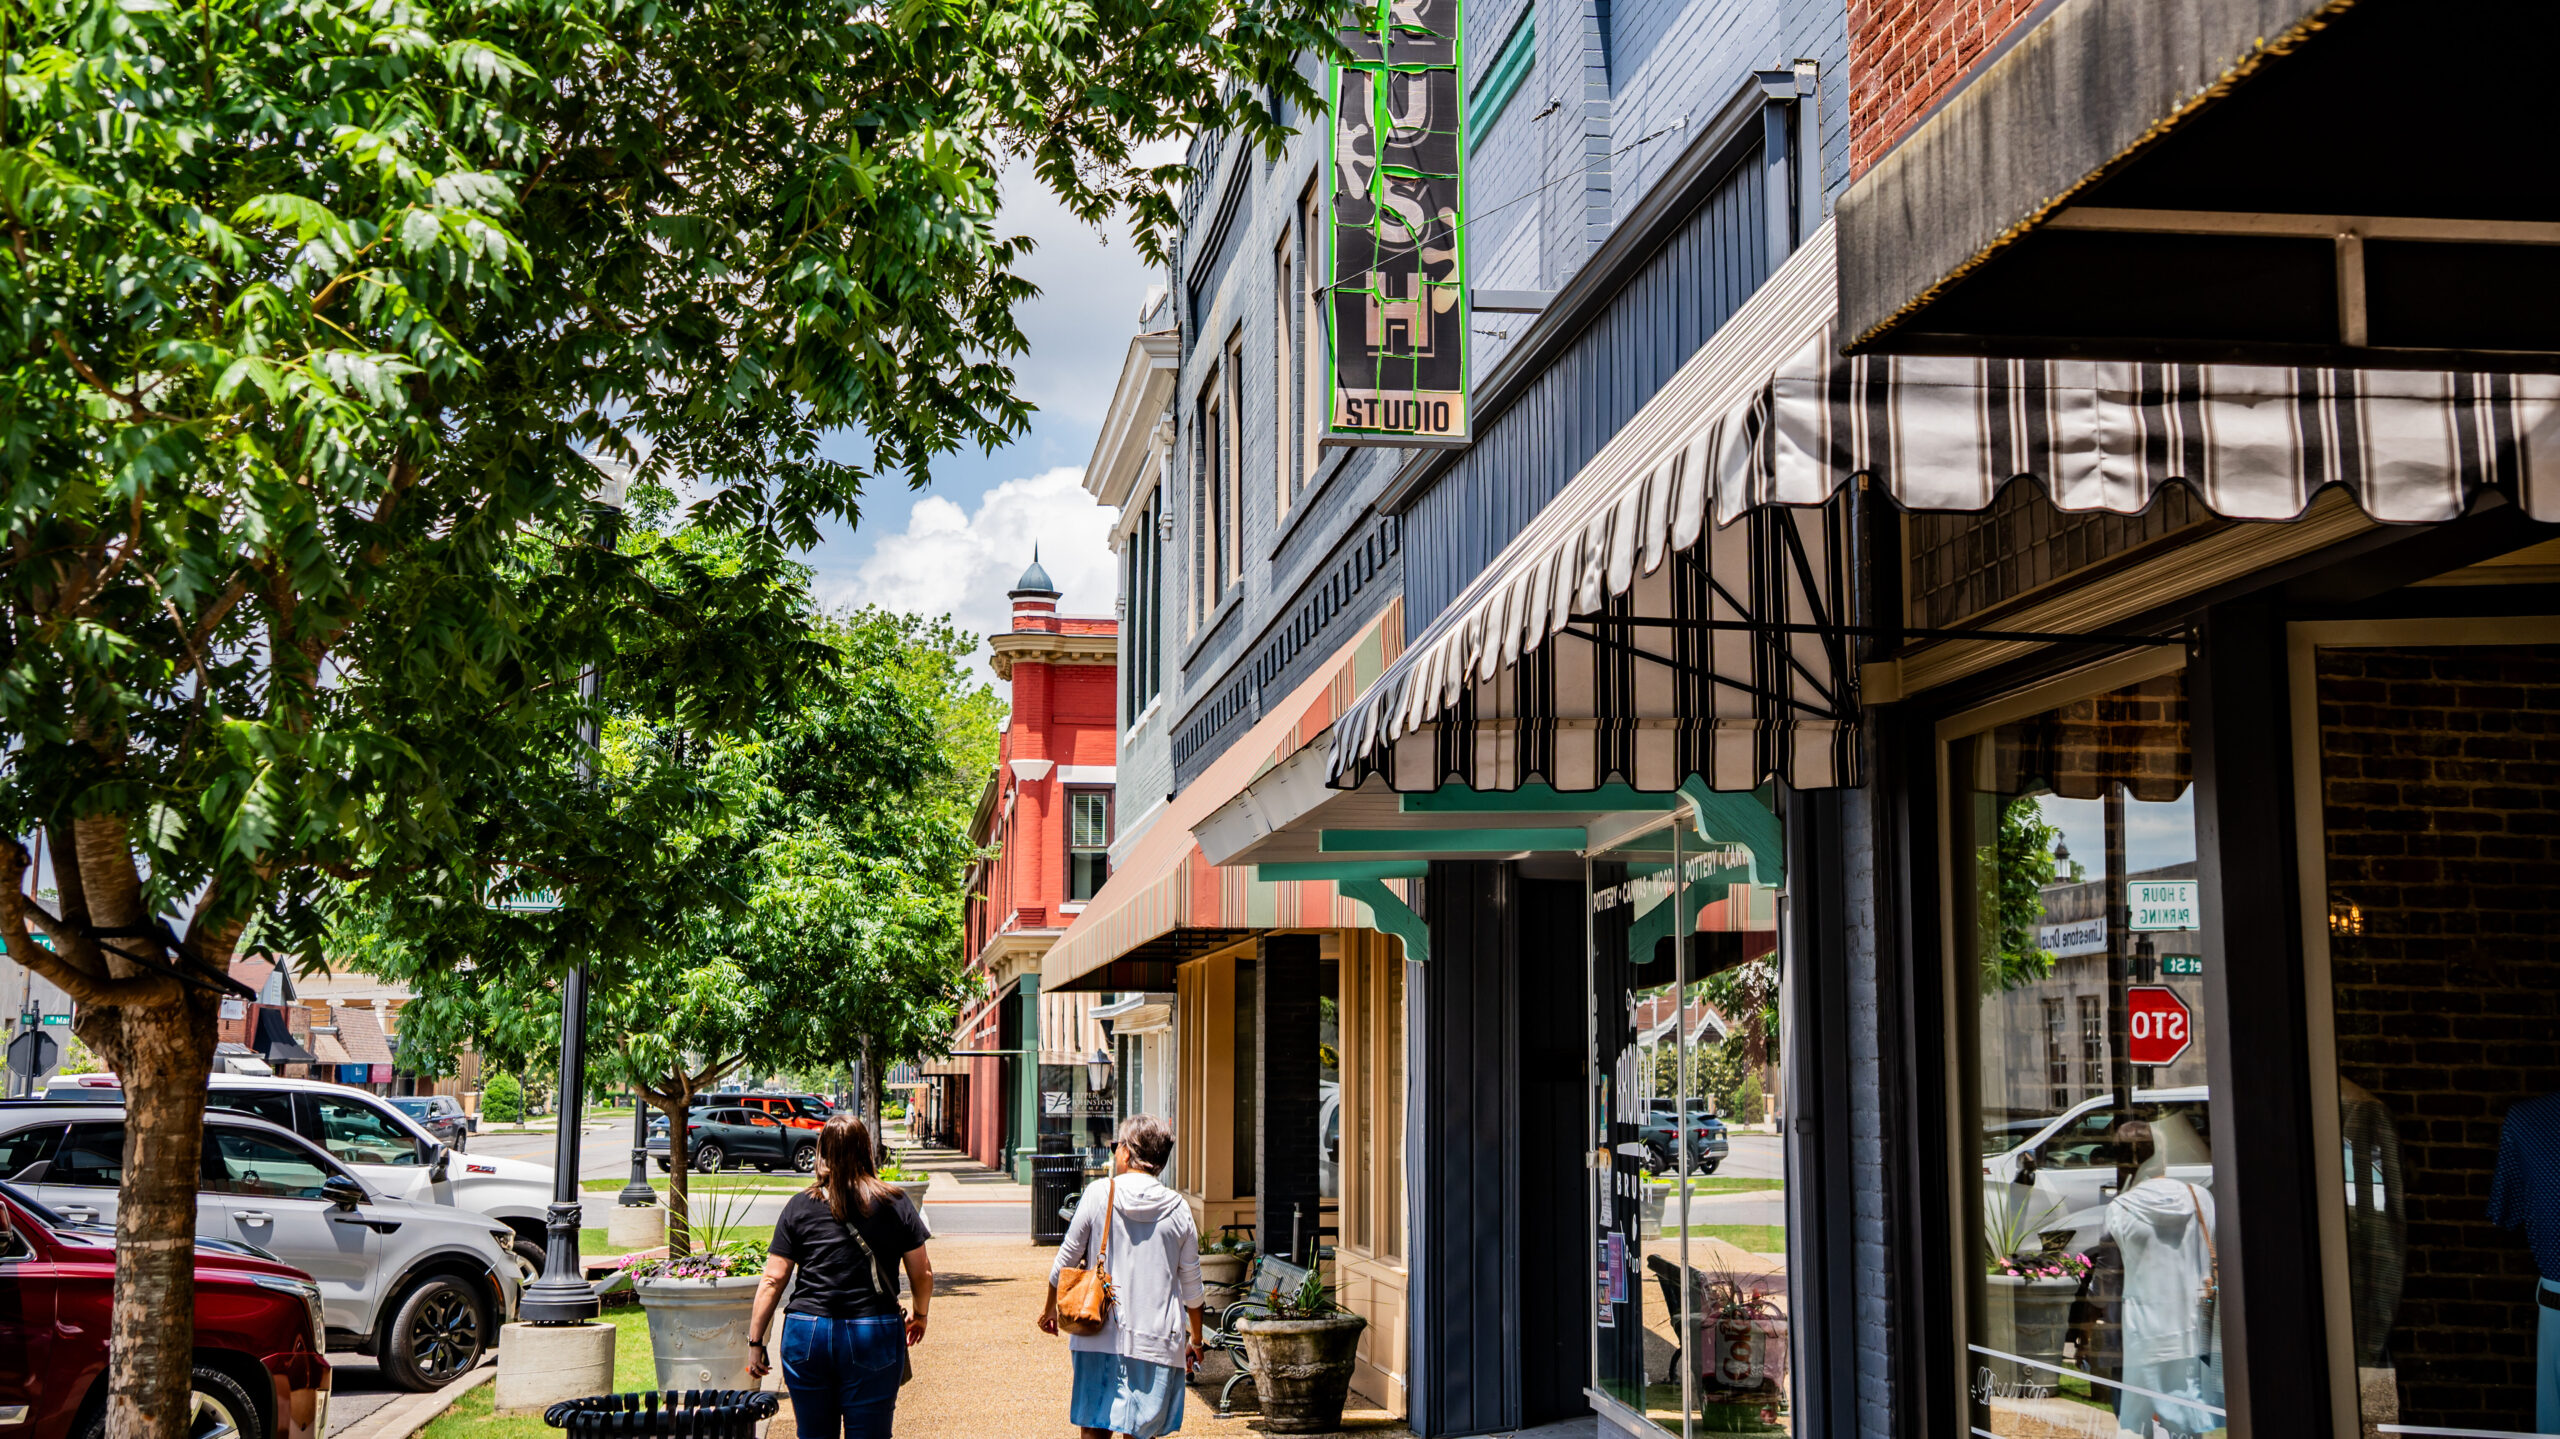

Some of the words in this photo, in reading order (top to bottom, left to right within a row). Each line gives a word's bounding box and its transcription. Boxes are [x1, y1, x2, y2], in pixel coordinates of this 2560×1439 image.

[1346, 398, 1450, 432] STUDIO
[1685, 849, 1717, 889] POTTERY
[1593, 885, 1618, 913] POTTERY
[1622, 876, 1647, 905] CANVAS
[1652, 868, 1674, 895] WOOD
[1616, 1042, 1652, 1127] BROKEN
[1617, 1171, 1653, 1205] BRUSH
